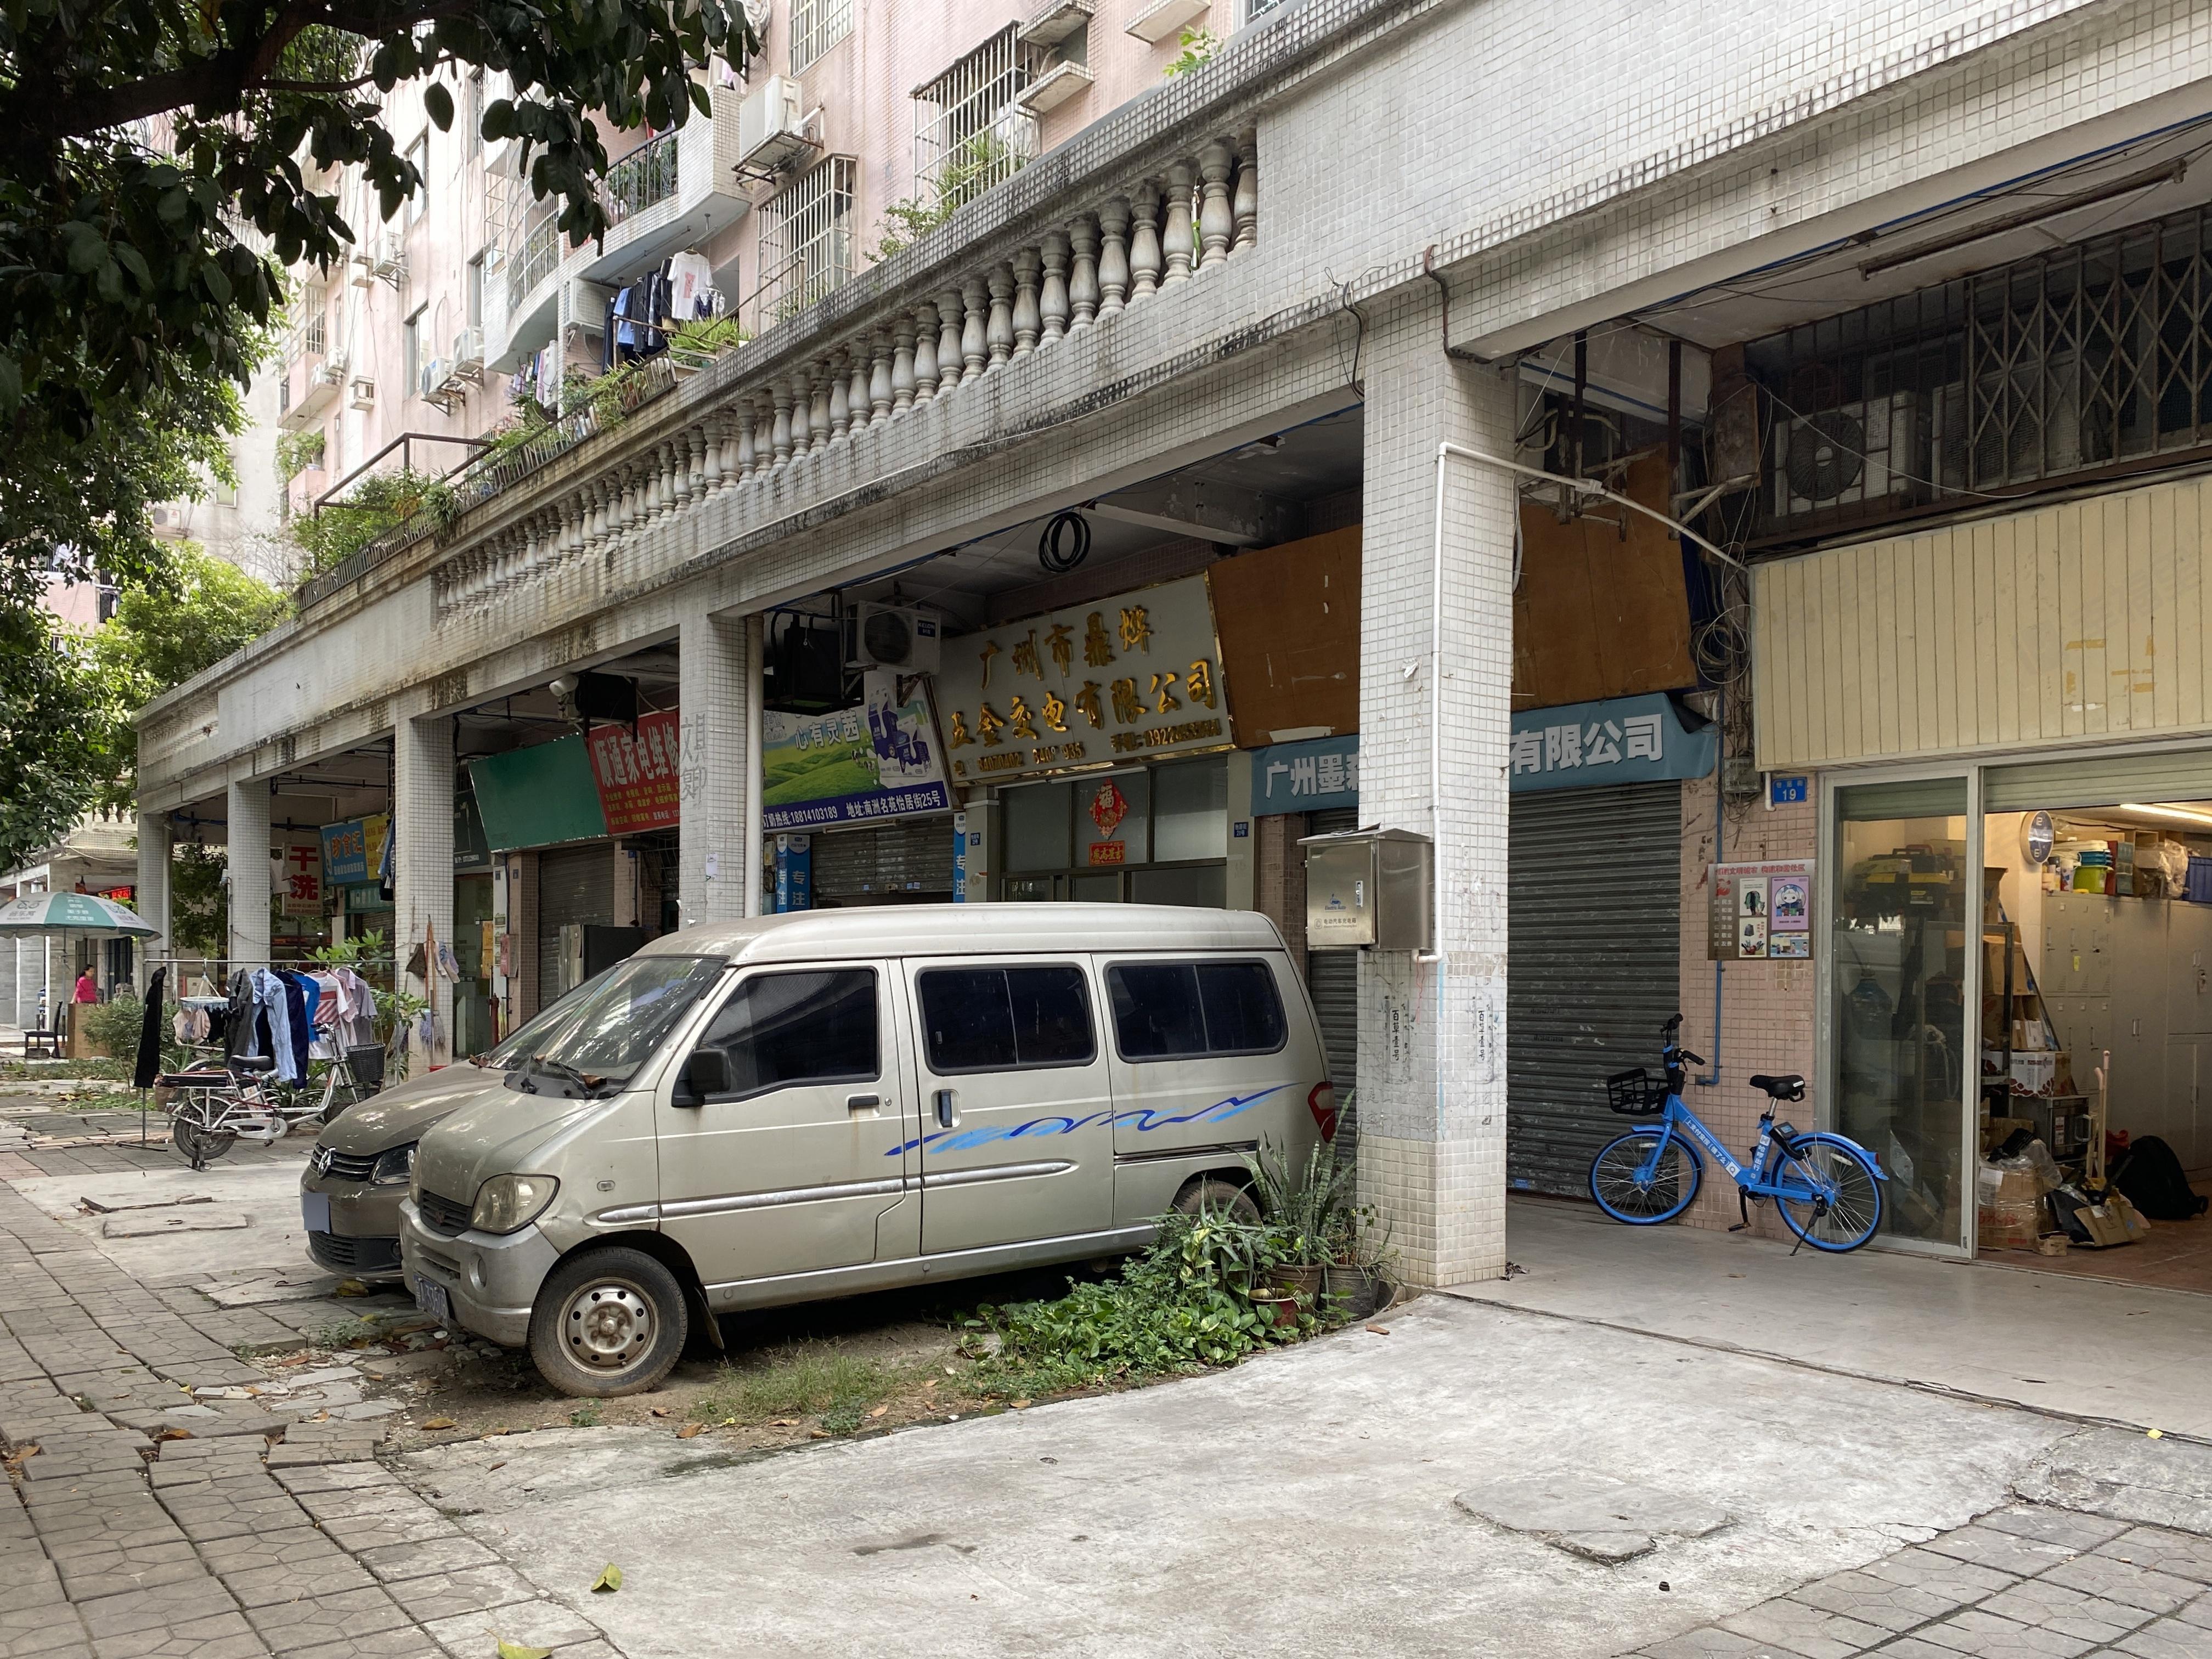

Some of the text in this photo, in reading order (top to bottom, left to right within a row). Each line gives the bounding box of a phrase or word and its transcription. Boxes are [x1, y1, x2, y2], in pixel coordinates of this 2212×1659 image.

[1512, 713, 1664, 775] 有限公司
[1782, 788, 1797, 801] 19
[289, 847, 318, 900] 干洗
[792, 870, 806, 905] 专注
